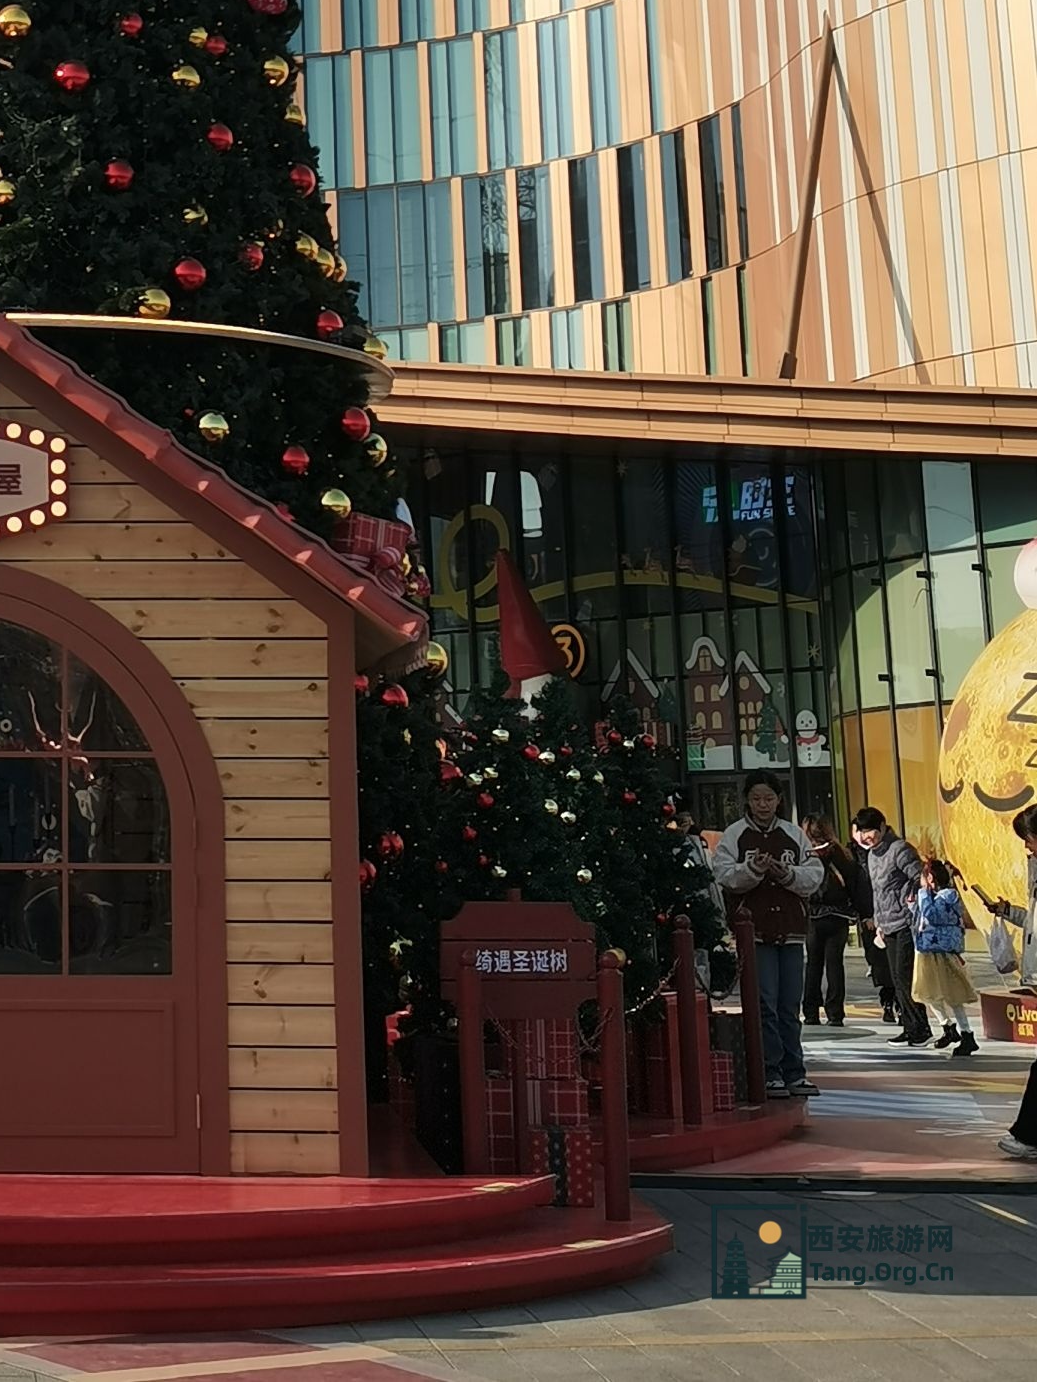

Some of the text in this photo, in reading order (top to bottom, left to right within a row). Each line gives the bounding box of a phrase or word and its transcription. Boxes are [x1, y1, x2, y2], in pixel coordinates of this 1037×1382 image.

[475, 948, 568, 973] 绮遇圣诞树
